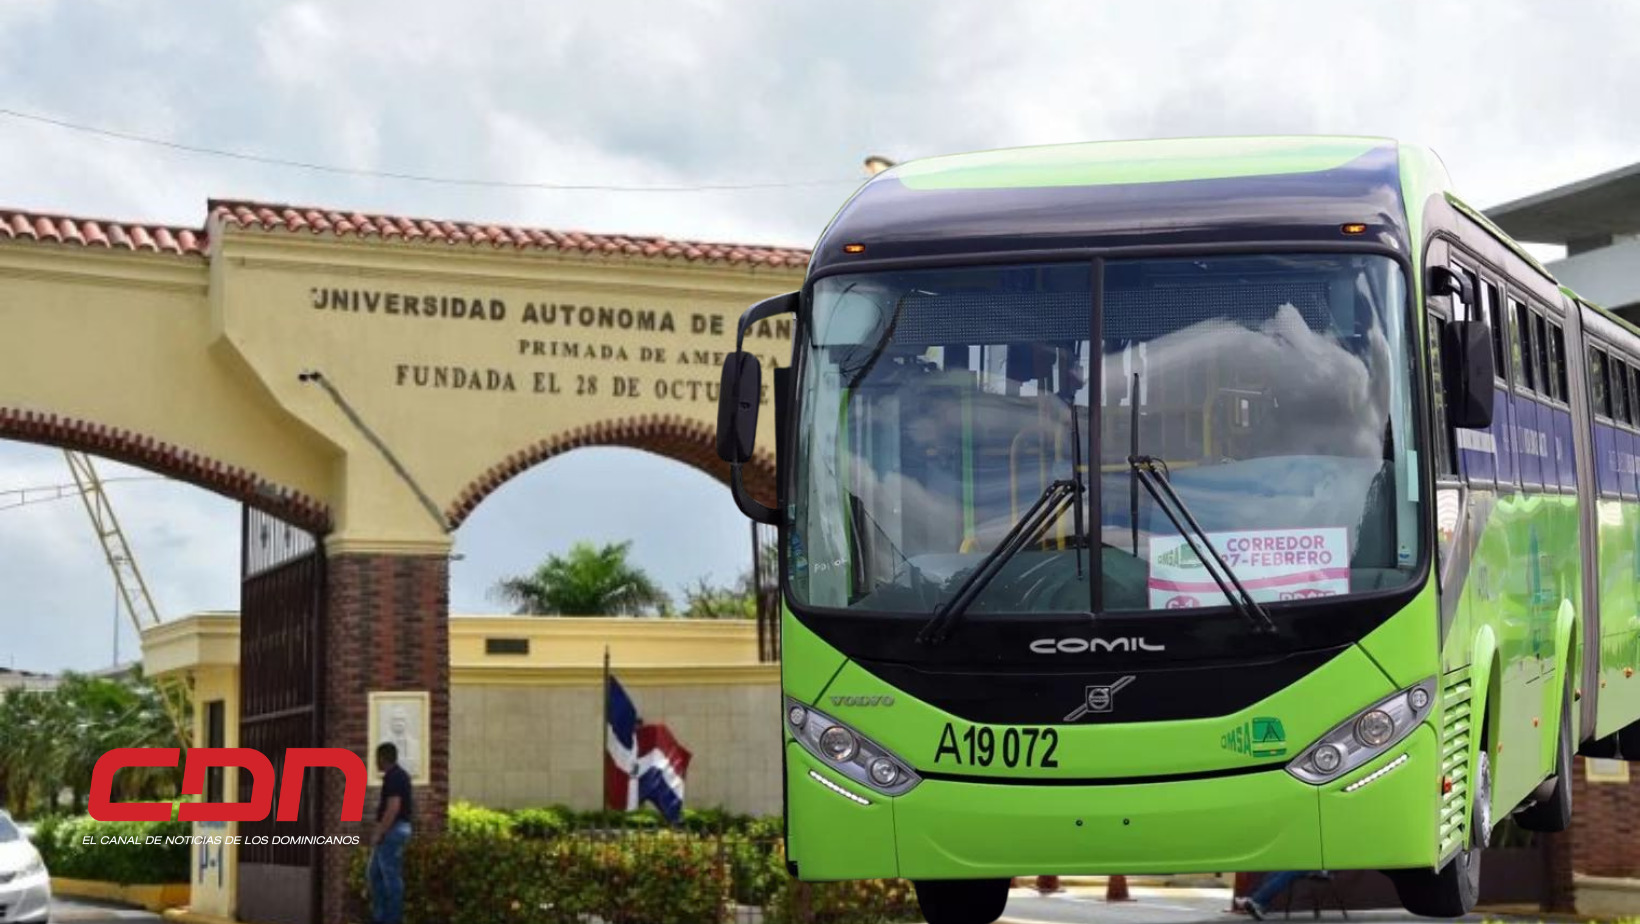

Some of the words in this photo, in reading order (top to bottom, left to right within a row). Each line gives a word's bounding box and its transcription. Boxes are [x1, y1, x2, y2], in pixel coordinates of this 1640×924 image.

[311, 287, 506, 321] UNIVERSIDAD
[522, 302, 675, 333] AUTONOMA
[692, 313, 724, 336] DE
[518, 338, 629, 361] PRIMADA
[640, 346, 666, 363] DE
[677, 349, 778, 368] AMEA
[395, 364, 516, 392] FUNDADA
[533, 371, 560, 394] EL
[575, 373, 598, 396] 28
[612, 375, 641, 398] DE
[655, 379, 769, 405] OCTUE
[1226, 534, 1325, 553] CORREDOR
[1029, 637, 1166, 654] COMIL
[830, 695, 896, 707] VOLVO
[934, 722, 995, 767] A19
[1002, 727, 1059, 768] 072
